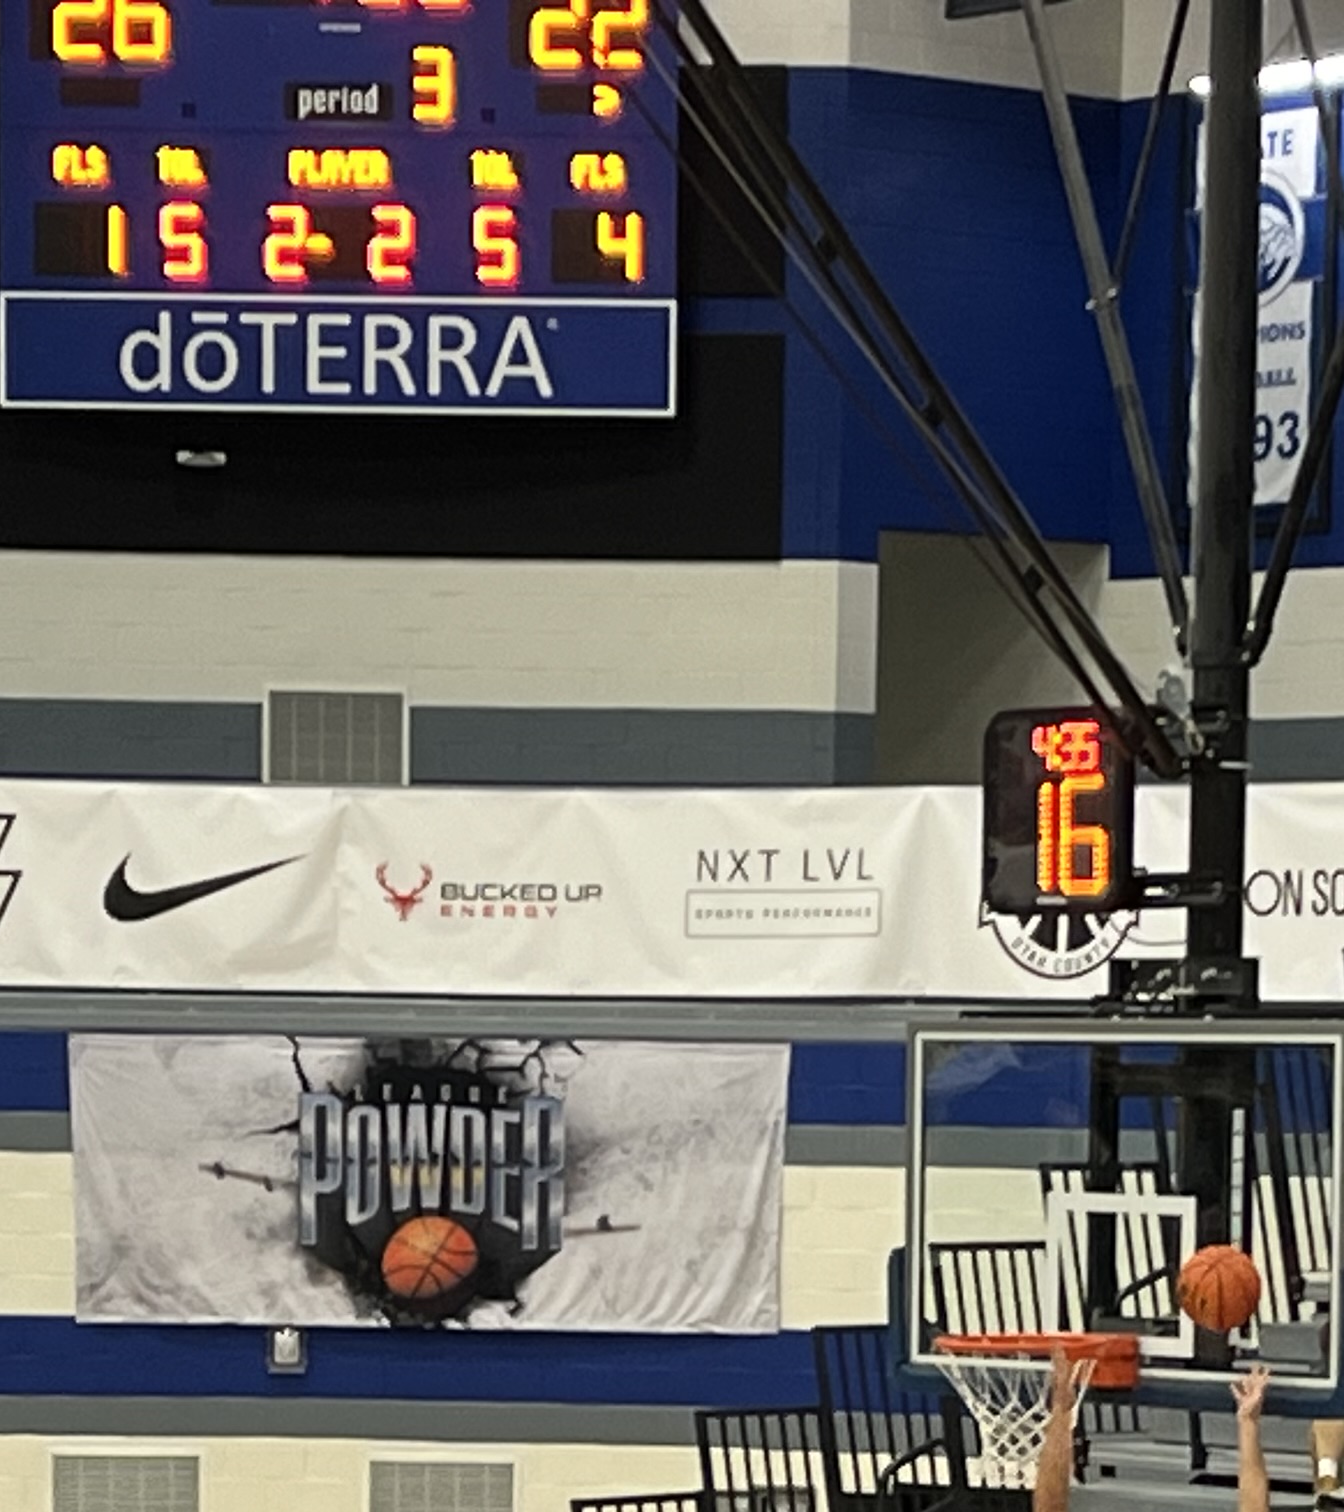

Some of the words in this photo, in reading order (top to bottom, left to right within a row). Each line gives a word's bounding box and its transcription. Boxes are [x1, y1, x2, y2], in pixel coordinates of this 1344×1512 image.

[53, 0, 172, 64] 26
[297, 84, 379, 121] period
[413, 44, 455, 127] 3
[107, 204, 129, 278] 1
[158, 201, 208, 286] 5
[472, 205, 520, 287] 5
[596, 210, 646, 284] 4
[1252, 411, 1301, 463] 93
[1035, 772, 1111, 896] 16
[440, 883, 557, 902] BUCKED
[564, 883, 603, 903] UP
[695, 849, 781, 882] NXT
[801, 848, 876, 882] LVL
[1246, 868, 1303, 916] ON
[440, 904, 559, 919] ENERGY
[298, 1092, 567, 1250] POWDER
